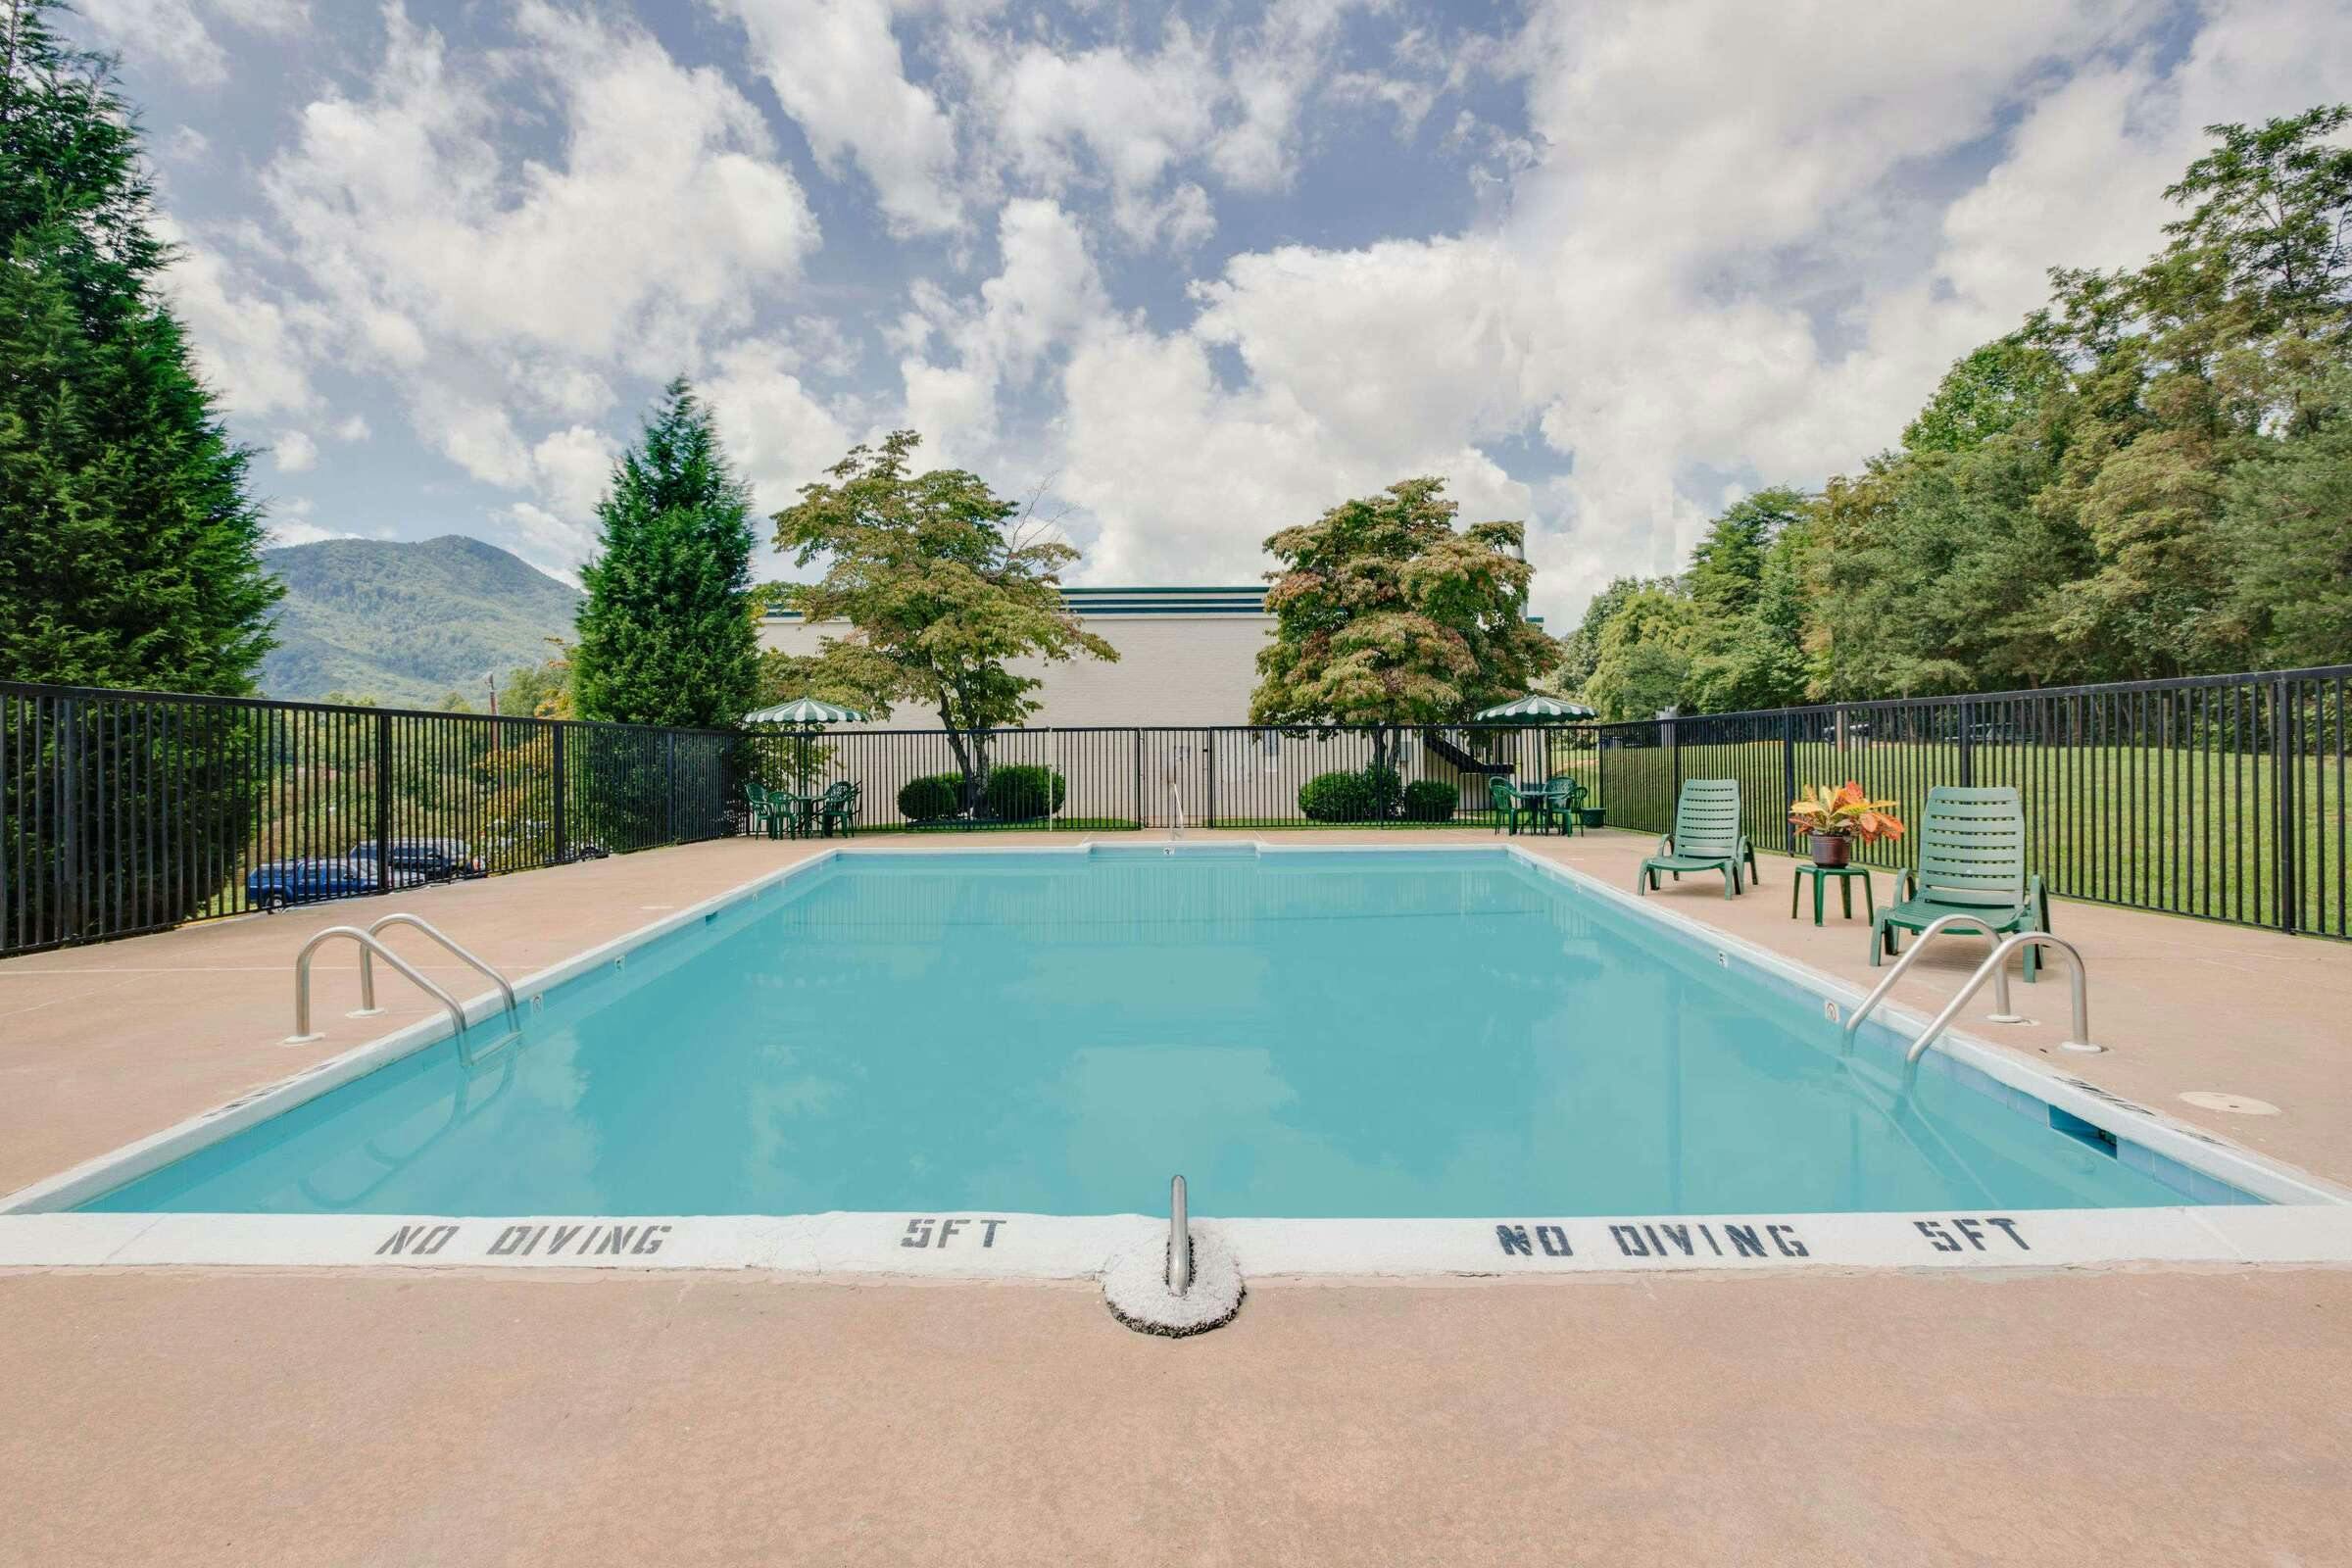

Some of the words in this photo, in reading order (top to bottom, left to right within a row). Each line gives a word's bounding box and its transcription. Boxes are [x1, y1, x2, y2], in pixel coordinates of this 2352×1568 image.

[374, 1225, 461, 1255] NO
[485, 1225, 672, 1256] DIVING
[900, 1218, 1007, 1249] 5FT
[1495, 1224, 1574, 1256] NO
[1609, 1223, 1810, 1258] DIVING
[1912, 1217, 2032, 1252] 5FT
